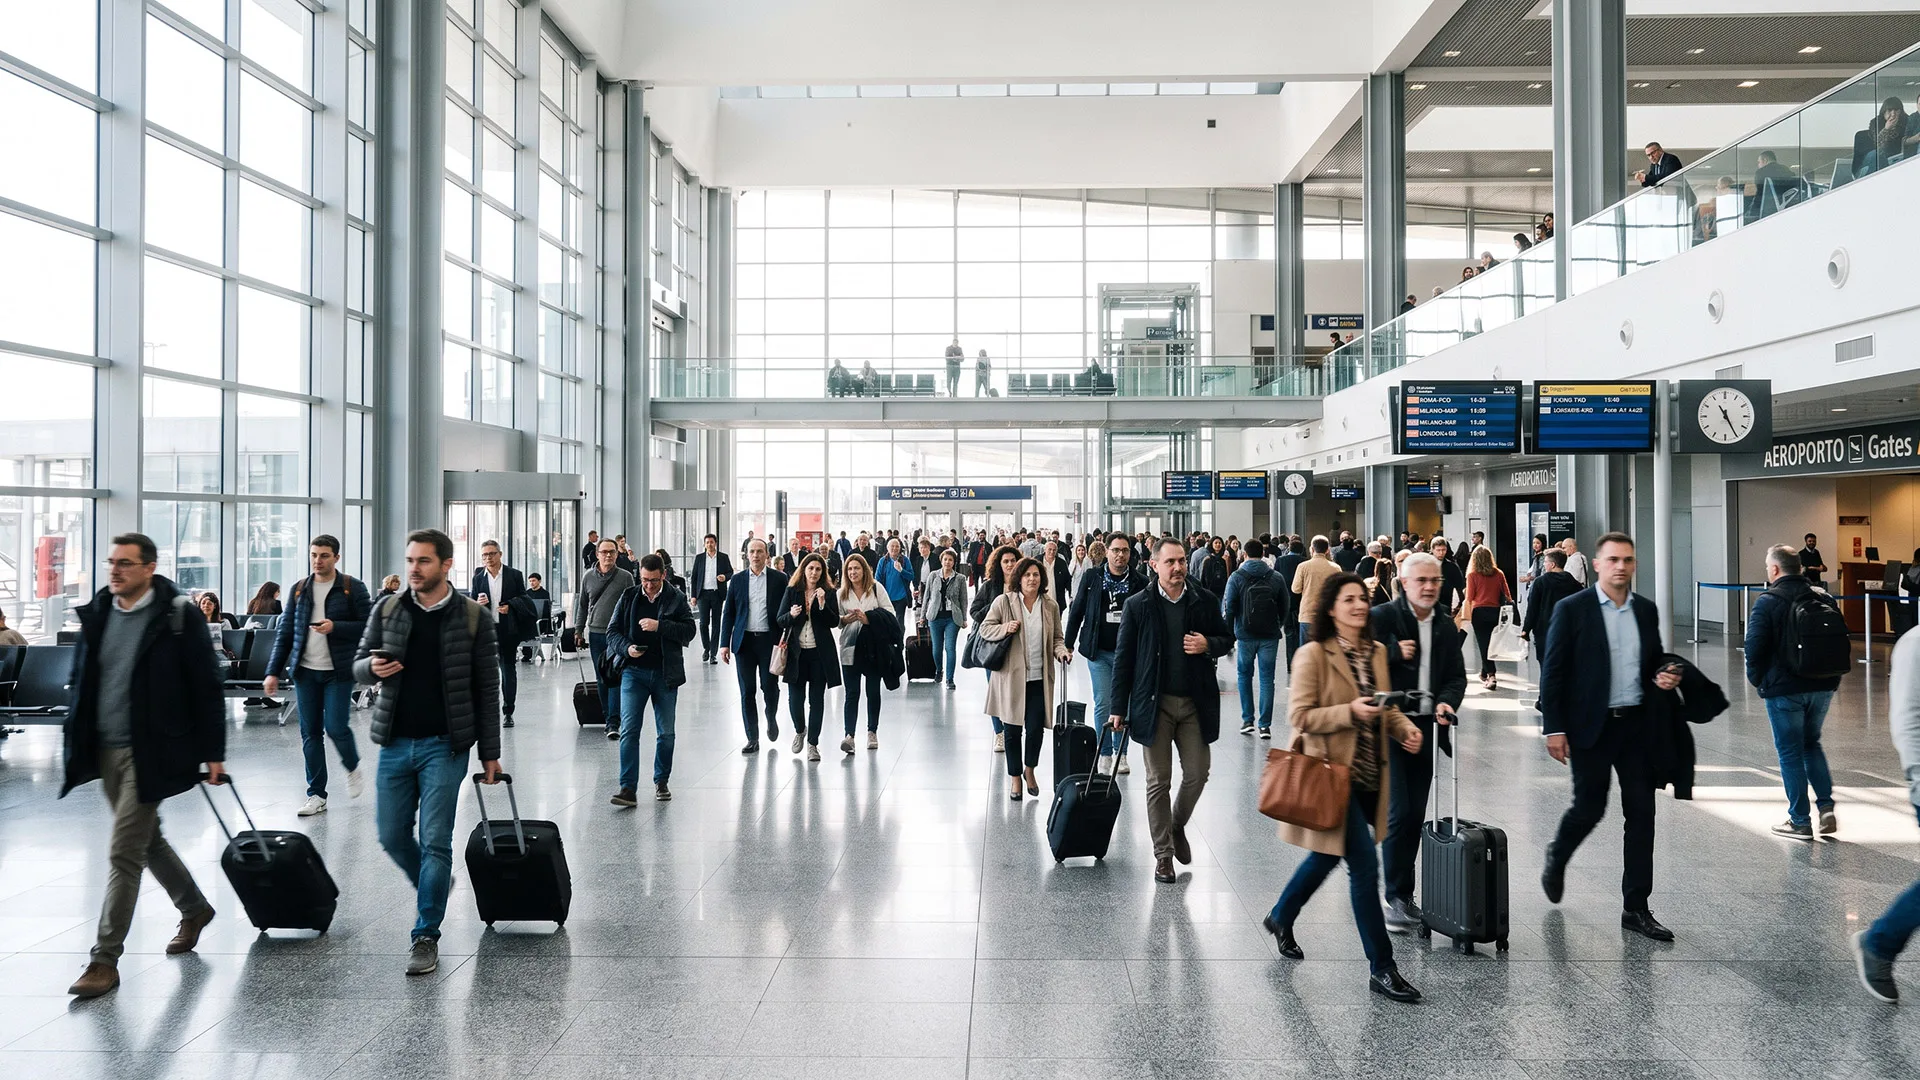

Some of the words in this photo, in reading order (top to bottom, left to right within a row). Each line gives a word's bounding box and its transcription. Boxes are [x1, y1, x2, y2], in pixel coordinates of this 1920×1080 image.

[1764, 438, 1844, 468] AEROPORTO
[1868, 434, 1912, 459] Gates
[1510, 470, 1548, 487] AEROPORTO
